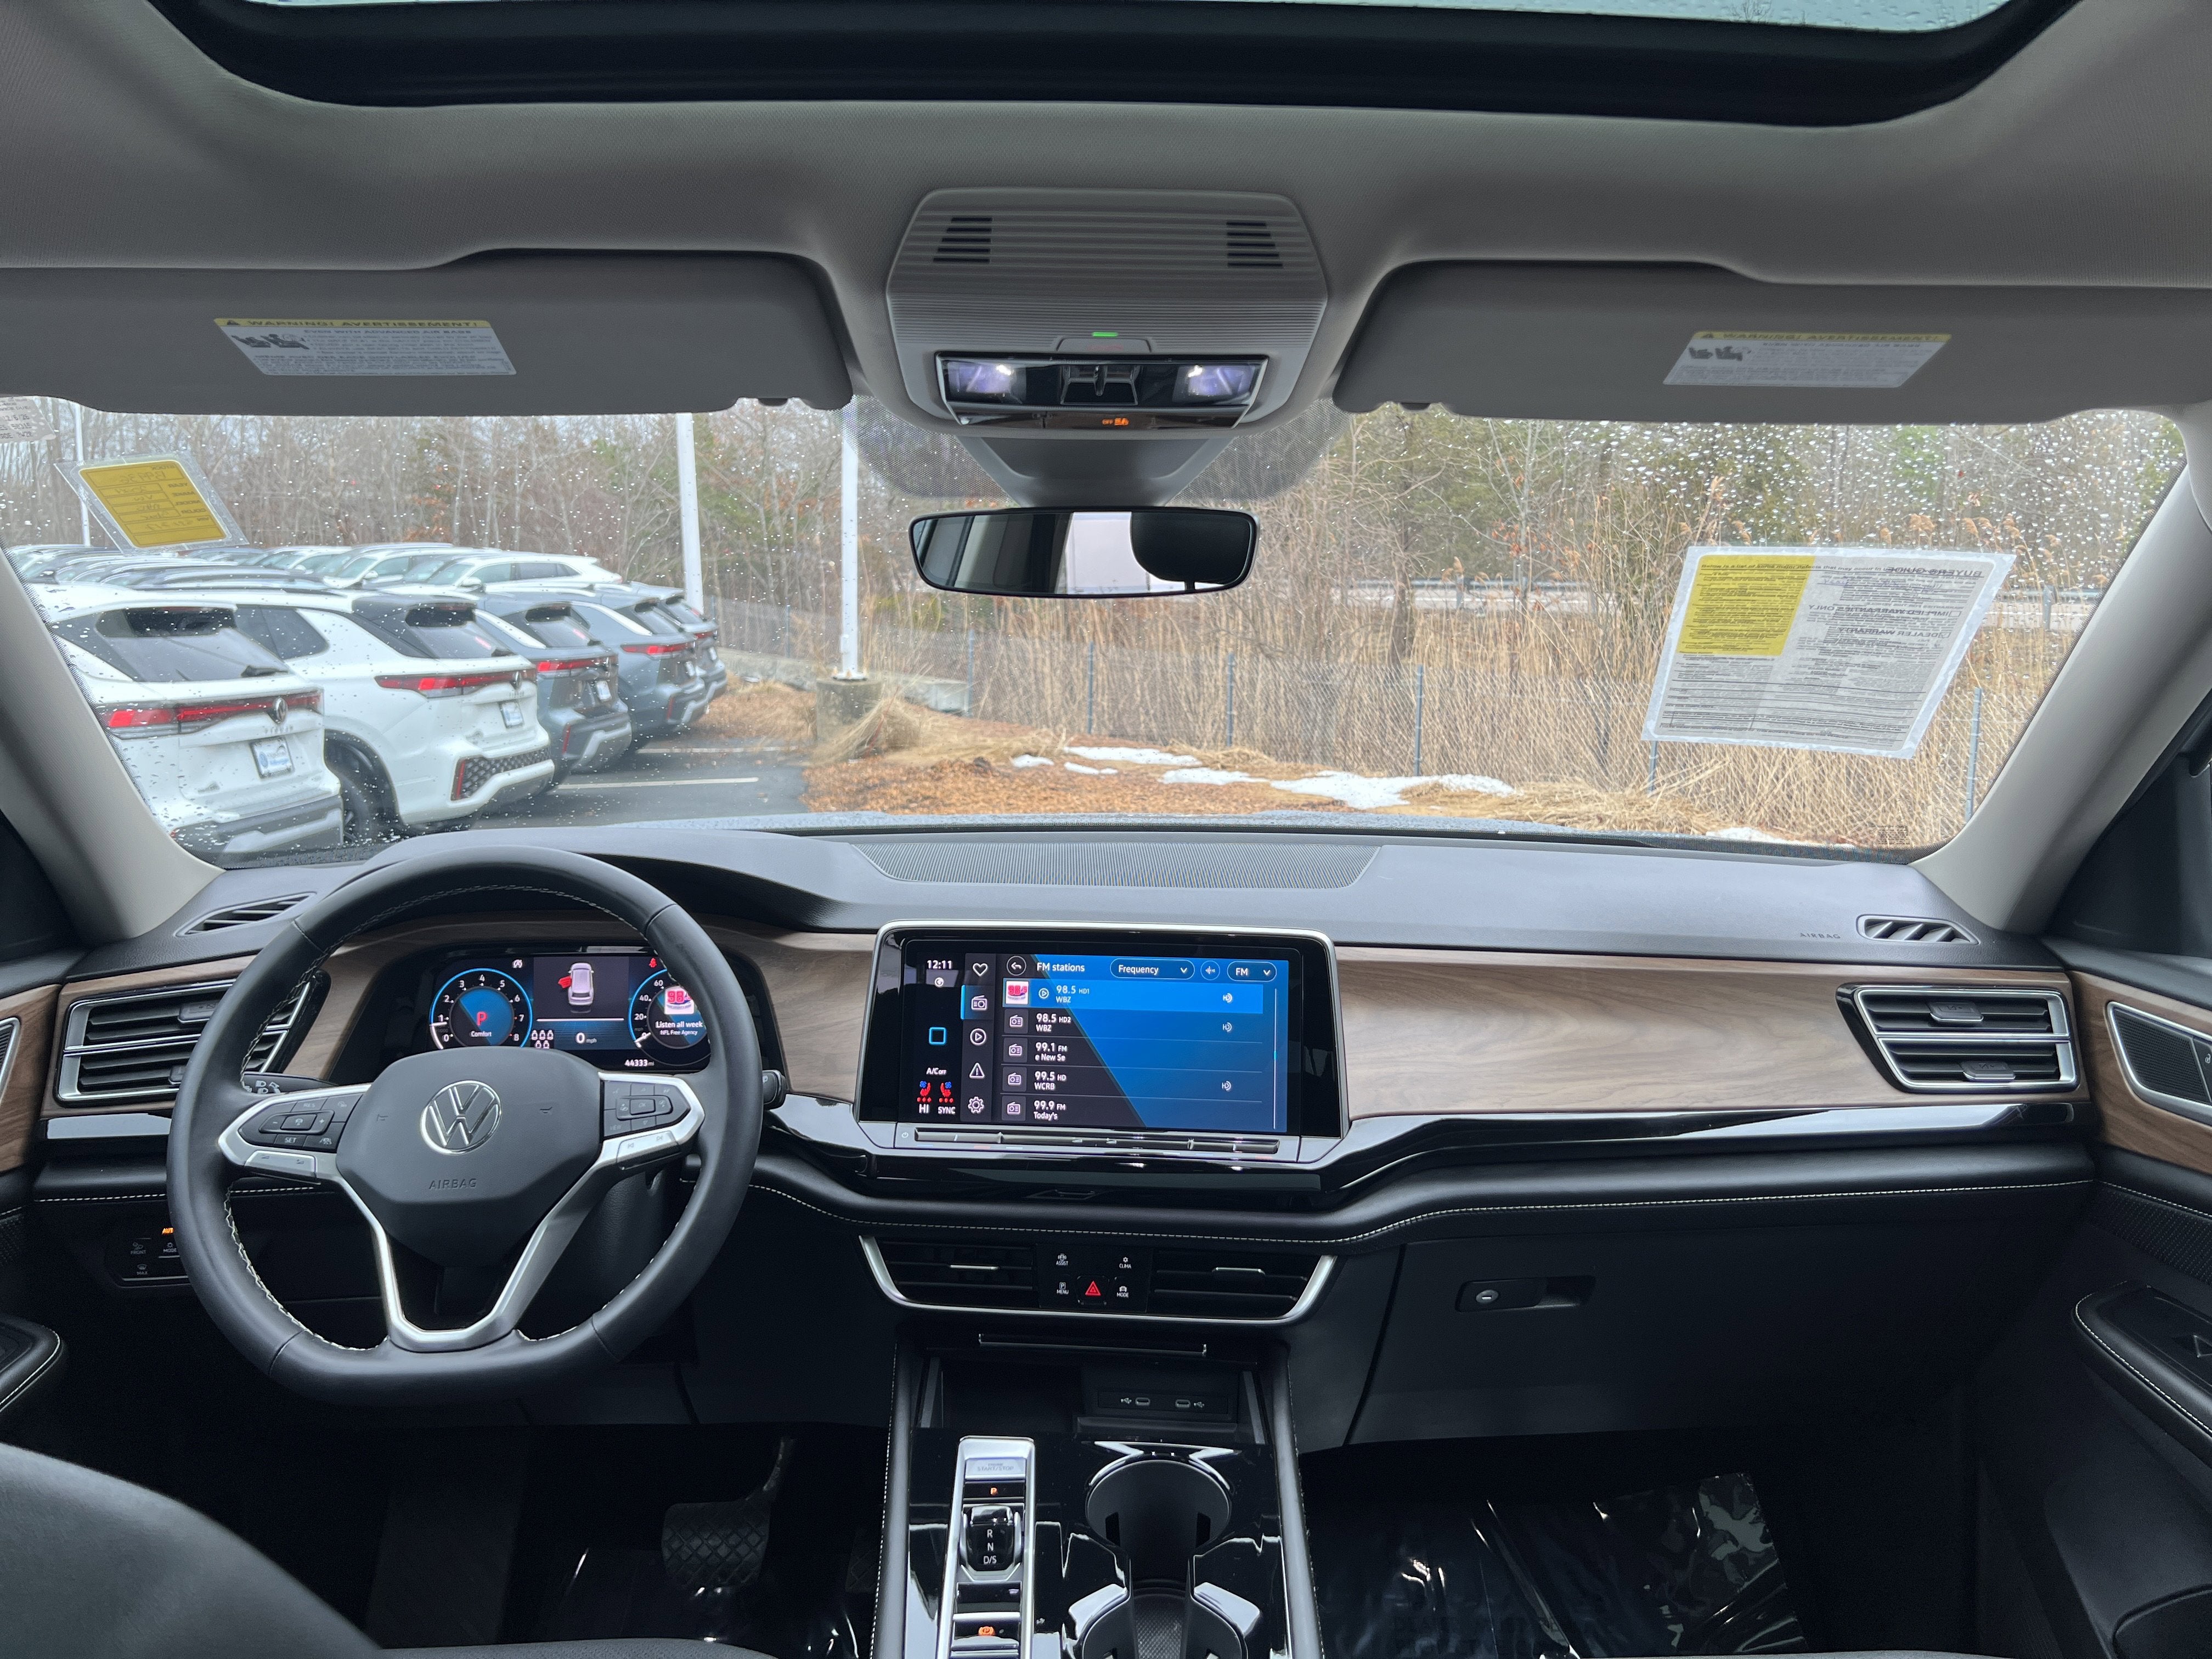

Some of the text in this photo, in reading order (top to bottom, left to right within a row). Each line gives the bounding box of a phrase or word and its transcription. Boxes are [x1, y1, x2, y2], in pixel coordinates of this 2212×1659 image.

[927, 960, 952, 969] 12:11
[1036, 962, 1085, 972] FM stations
[1118, 964, 1159, 975] Frequency
[1235, 968, 1249, 976] FM
[479, 974, 485, 982] 4
[459, 979, 465, 988] 3
[500, 979, 505, 988] 5
[1056, 985, 1076, 995] 98.5
[444, 994, 450, 1003] 2
[515, 994, 521, 1002] 6
[438, 1014, 444, 1022] 1
[476, 1011, 488, 1026] P
[519, 1014, 524, 1022] 7
[1036, 1013, 1057, 1024] 98.5
[1035, 1024, 1052, 1032] WBZ
[443, 1034, 449, 1042] 0
[514, 1033, 520, 1041] 8
[575, 1032, 585, 1043] 0
[1035, 1042, 1056, 1052] 99.1
[1057, 1053, 1066, 1062] Se
[1034, 1071, 1056, 1081] 99.5
[1034, 1082, 1056, 1091] WCRB
[918, 1103, 930, 1114] HI
[1034, 1100, 1055, 1110] 99.9
[938, 1106, 956, 1115] SYNC
[1033, 1111, 1058, 1121] Today's
[429, 1178, 477, 1190] AIRBAG
[986, 1528, 993, 1538] R
[987, 1542, 994, 1551] N
[983, 1555, 997, 1565] D/S
